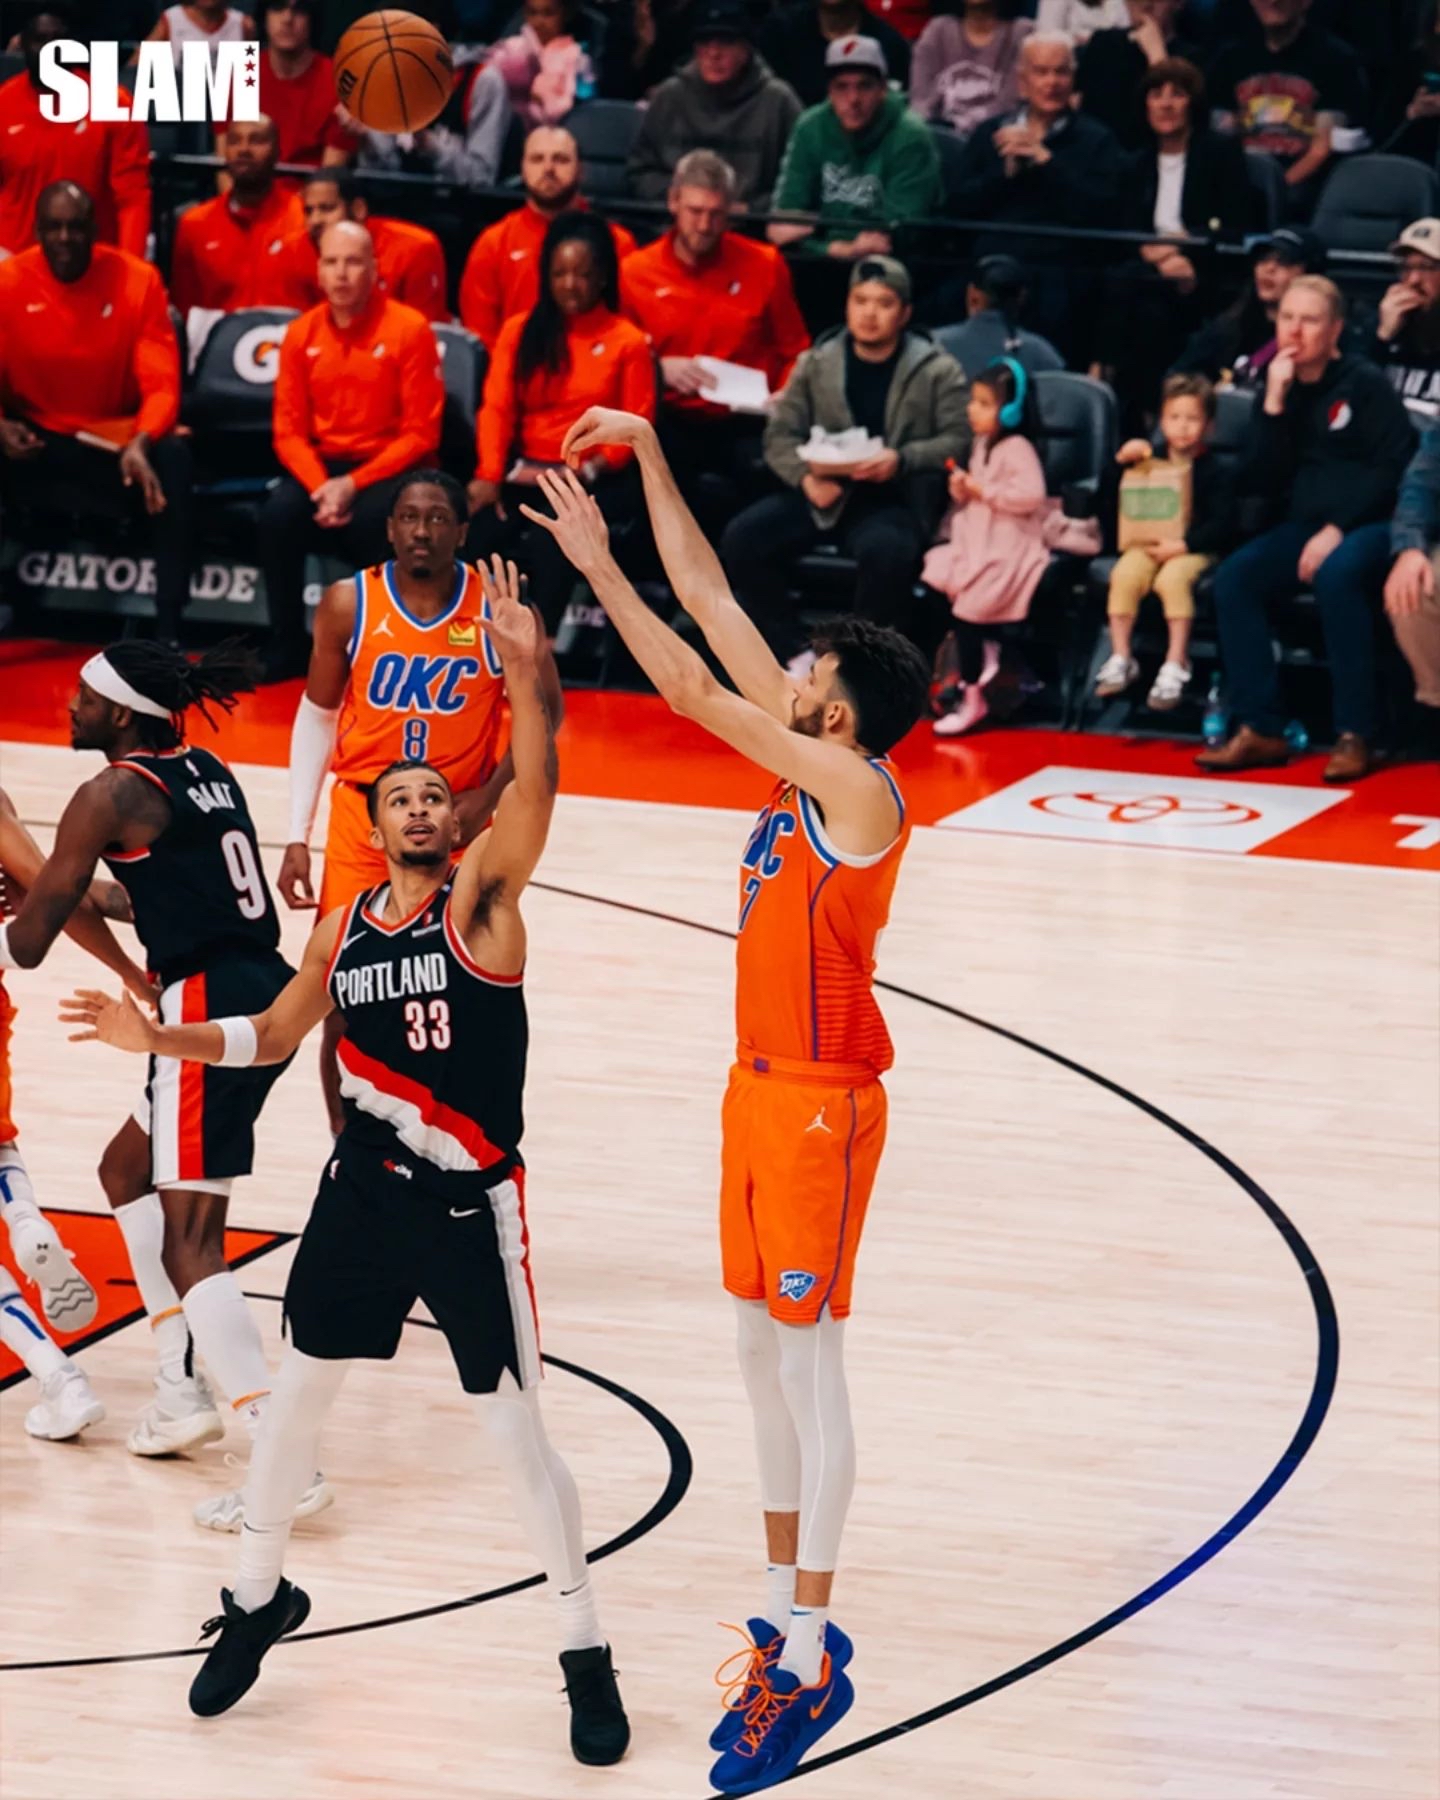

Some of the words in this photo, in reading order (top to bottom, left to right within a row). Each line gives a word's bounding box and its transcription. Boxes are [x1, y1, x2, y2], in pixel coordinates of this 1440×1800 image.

[367, 651, 481, 715] OKC
[403, 718, 430, 763] 8
[220, 829, 266, 920] 9
[738, 876, 762, 933] 7
[334, 952, 448, 1010] PORTLAND
[403, 998, 451, 1052] 33
